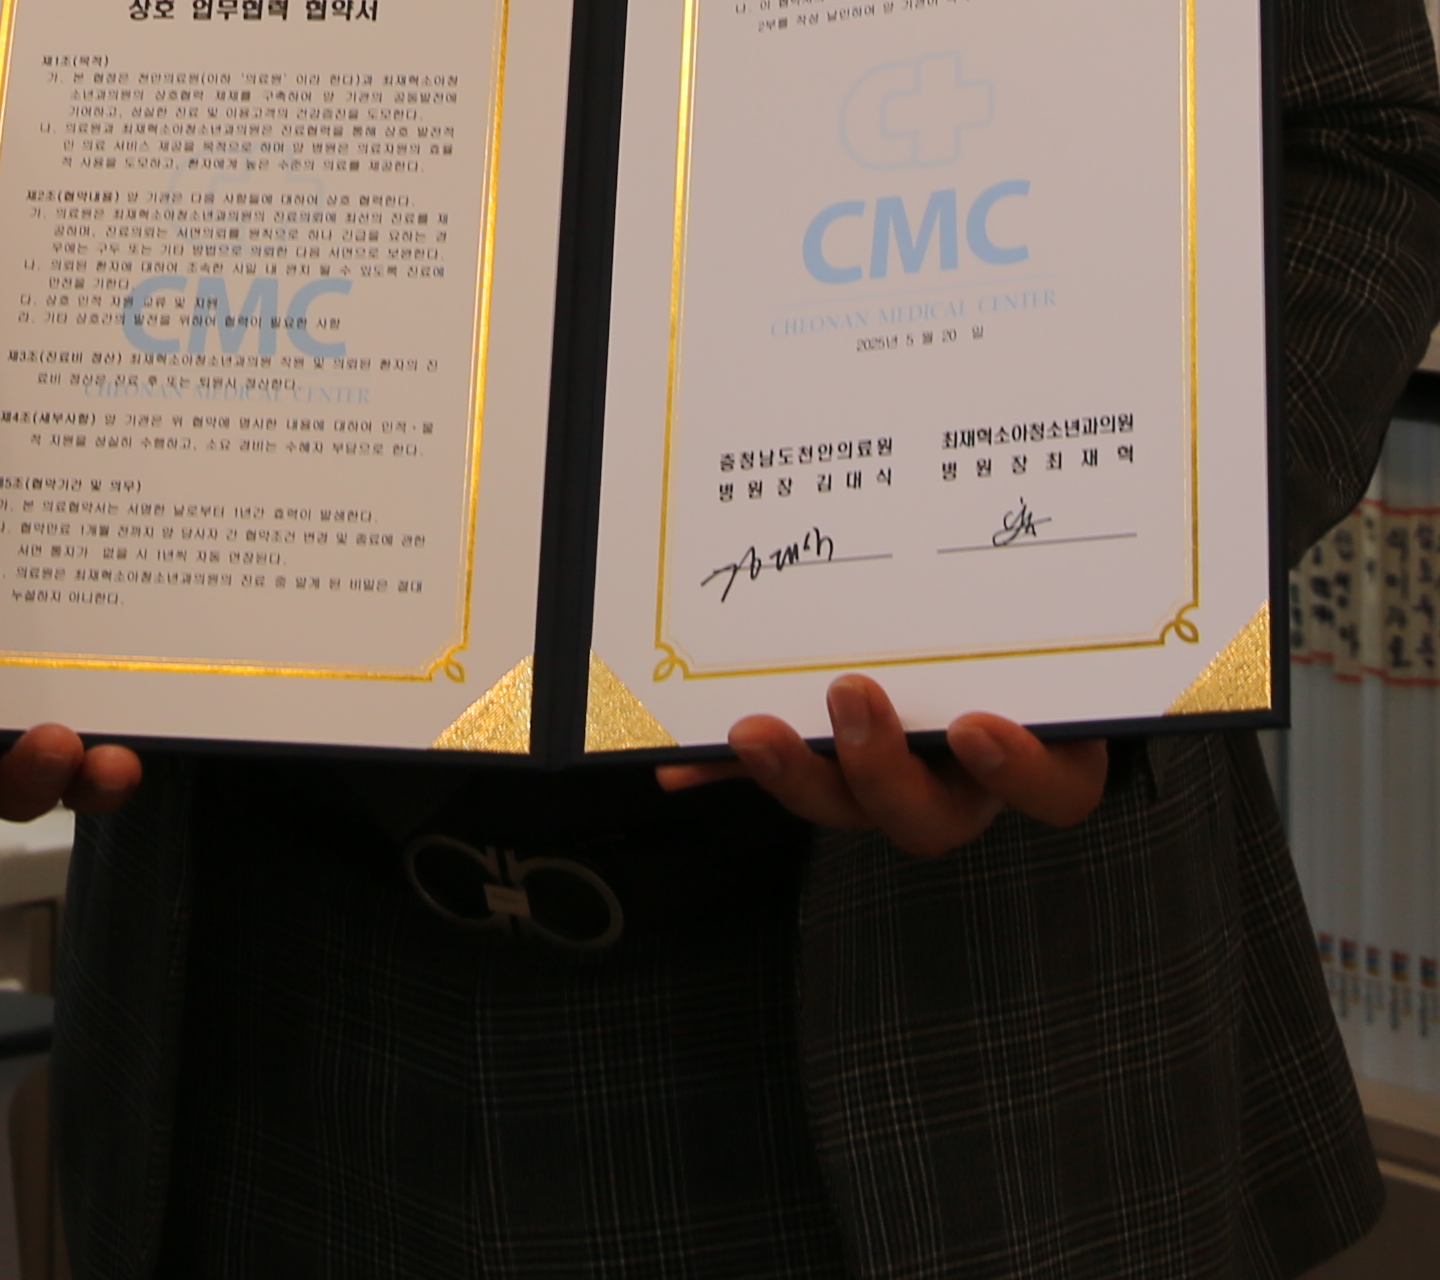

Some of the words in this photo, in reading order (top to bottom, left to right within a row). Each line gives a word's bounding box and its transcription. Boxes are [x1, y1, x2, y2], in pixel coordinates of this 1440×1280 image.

[802, 178, 1030, 284] CMC
[120, 274, 353, 360] CMC
[719, 436, 892, 472] 충청남도천안의료원
[941, 412, 1134, 450] 최재혁소아청소년과의원
